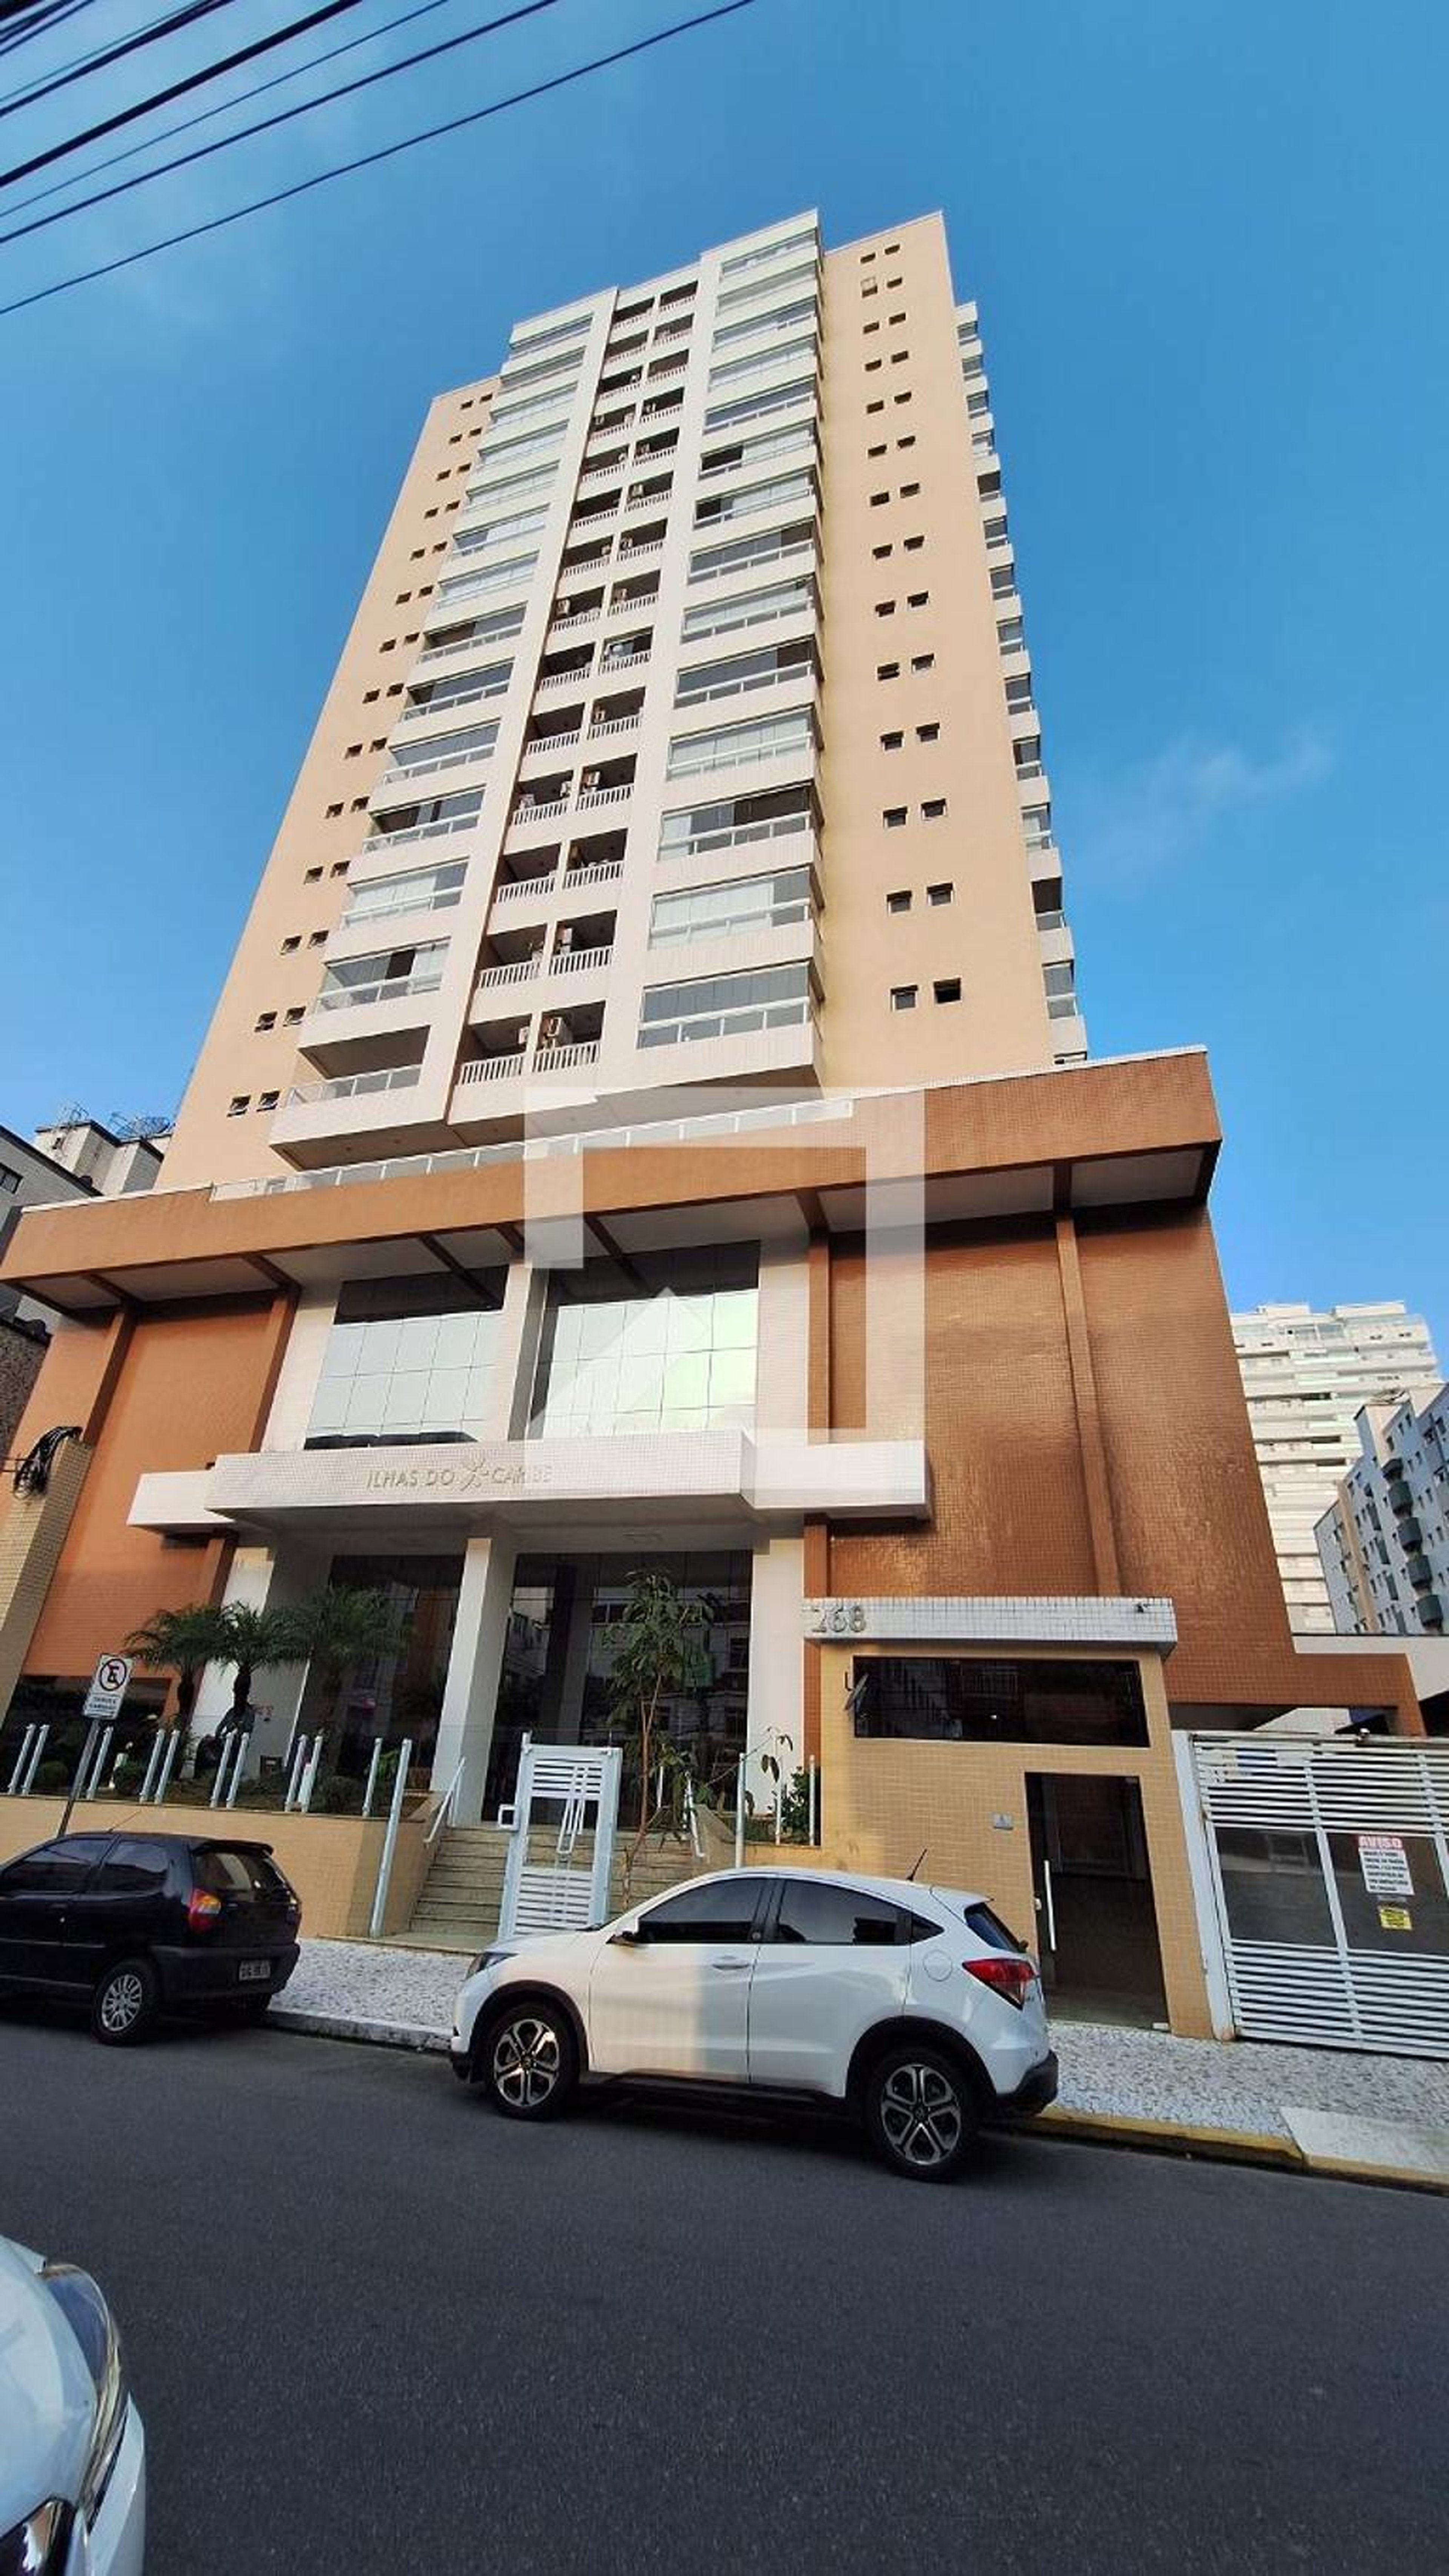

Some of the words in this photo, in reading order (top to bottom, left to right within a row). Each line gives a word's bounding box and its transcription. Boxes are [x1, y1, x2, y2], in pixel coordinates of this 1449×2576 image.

[366, 1469, 418, 1488] ILHAS
[425, 1469, 455, 1486] DO
[811, 1604, 867, 1632] 268
[1358, 1835, 1403, 1848] AVISO
